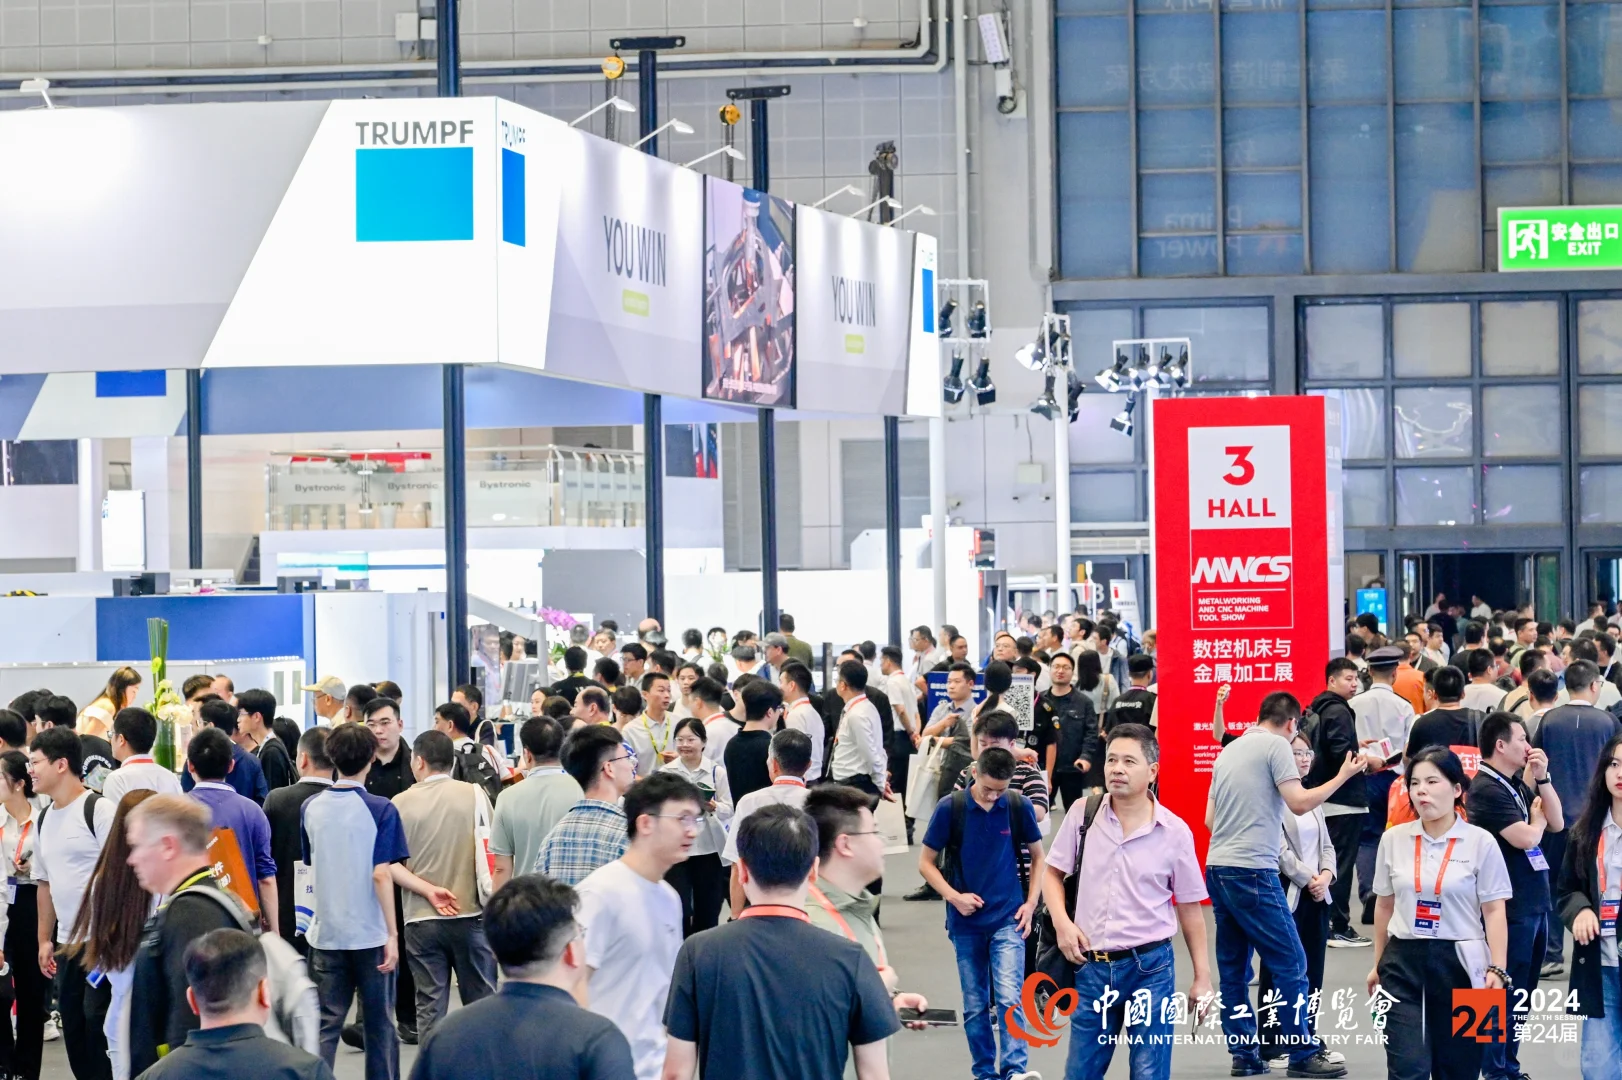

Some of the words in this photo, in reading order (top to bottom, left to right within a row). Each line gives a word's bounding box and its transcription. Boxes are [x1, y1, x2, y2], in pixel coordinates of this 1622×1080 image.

[355, 119, 474, 146] TRUMPF
[1550, 221, 1620, 242] 安全出口
[603, 214, 634, 279] YOU
[637, 224, 666, 288] WIN
[1567, 241, 1602, 256] EXIT
[831, 274, 853, 325] YOU
[855, 279, 876, 328] WIN
[1222, 445, 1255, 486] 3
[294, 483, 346, 493] Bystronic
[387, 481, 439, 491] Bystronic
[479, 480, 532, 490] Bystronic
[1207, 497, 1277, 518] HALL
[1190, 555, 1292, 584] MWCS
[1198, 596, 1262, 605] METALWORKING
[1198, 605, 1216, 613] AND
[1217, 605, 1233, 613] CNC
[1234, 604, 1269, 612] MACHINE
[1198, 613, 1219, 621] TOOL
[1221, 613, 1245, 621] SHOW
[1193, 637, 1292, 660] 数控机床与
[1193, 662, 1294, 684] 金属加工展
[1093, 951, 1110, 963] H
